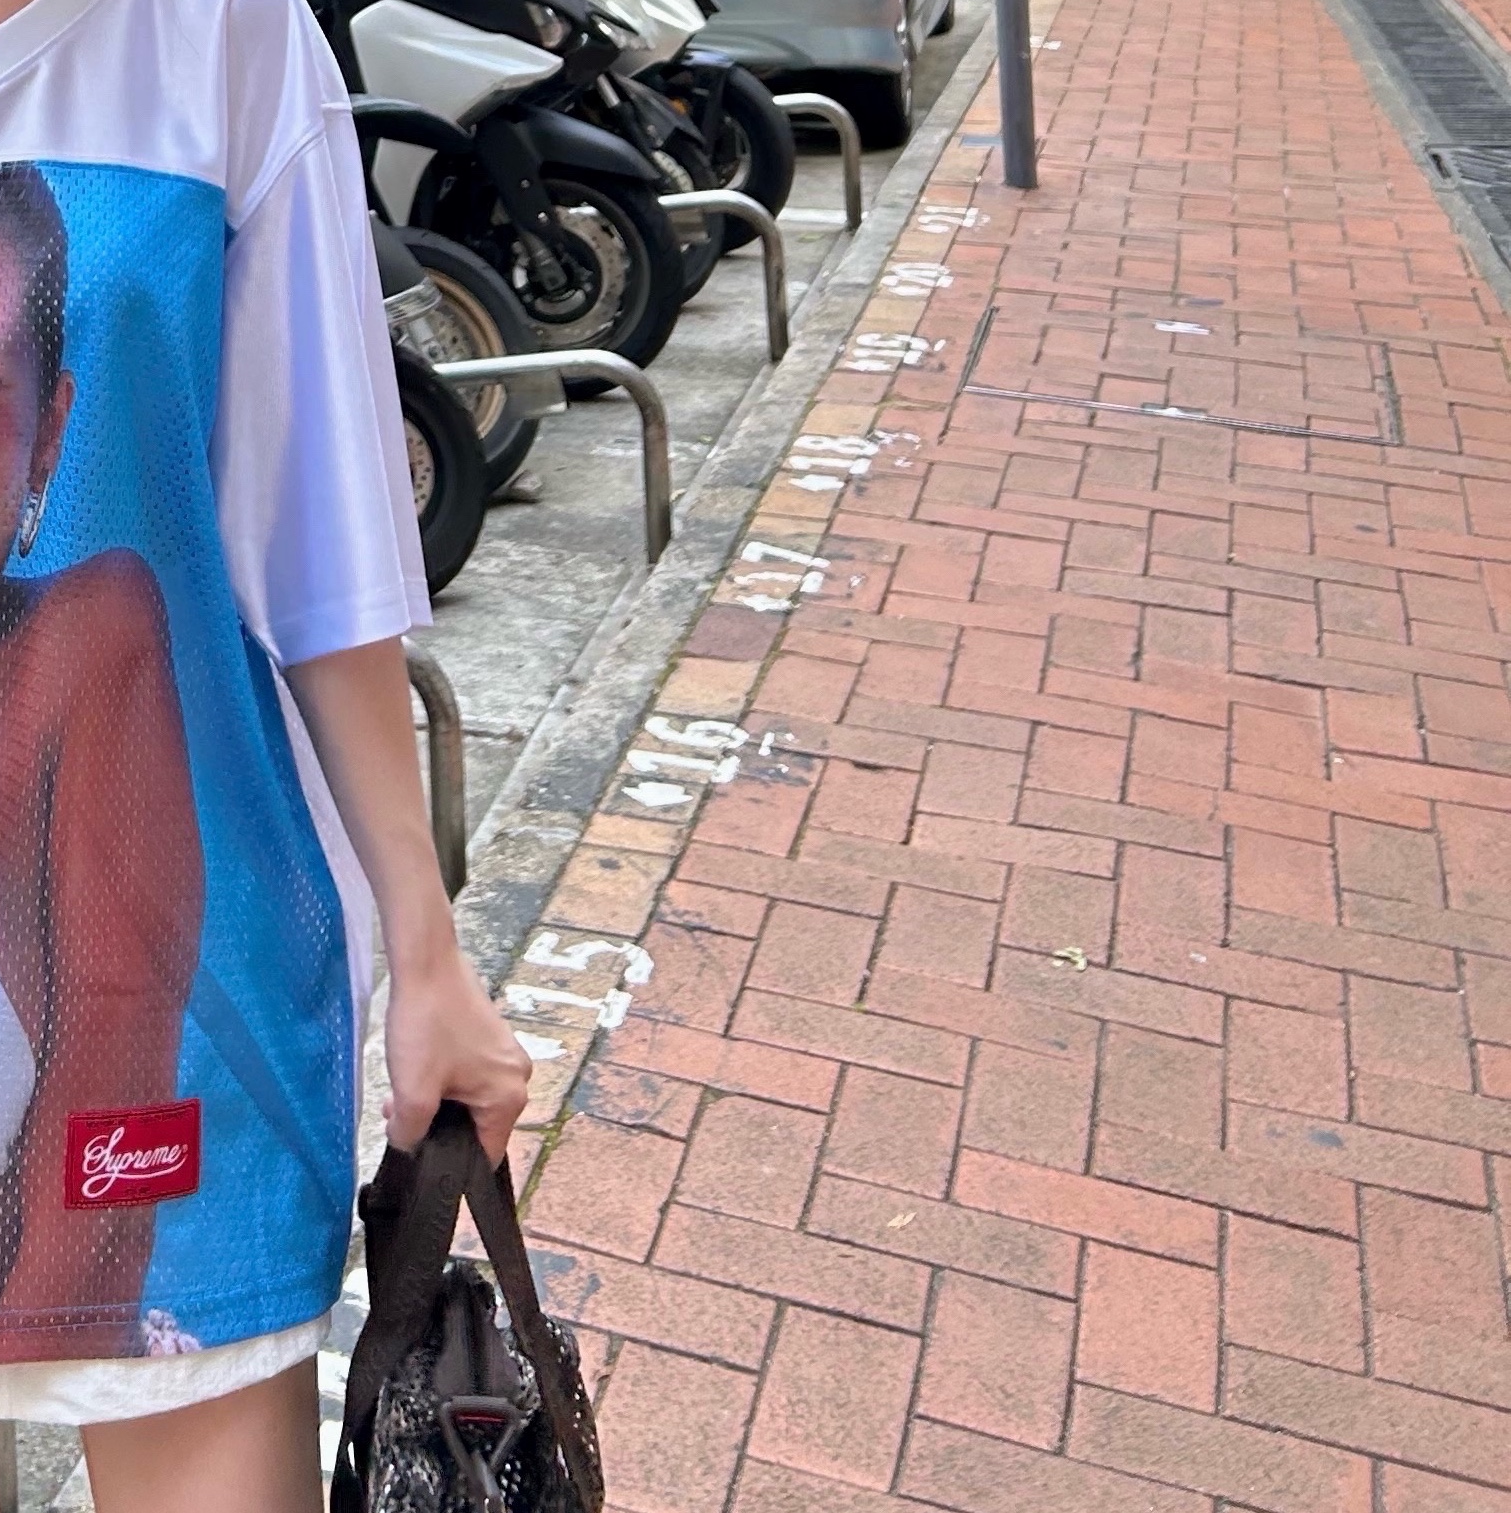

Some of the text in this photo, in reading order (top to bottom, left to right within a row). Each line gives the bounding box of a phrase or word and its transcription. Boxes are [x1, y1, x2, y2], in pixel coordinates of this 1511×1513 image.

[789, 434, 880, 475] 18
[734, 541, 831, 593] 17
[627, 716, 750, 784] 16
[504, 931, 655, 1029] 15
[81, 1126, 188, 1199] Supreme
